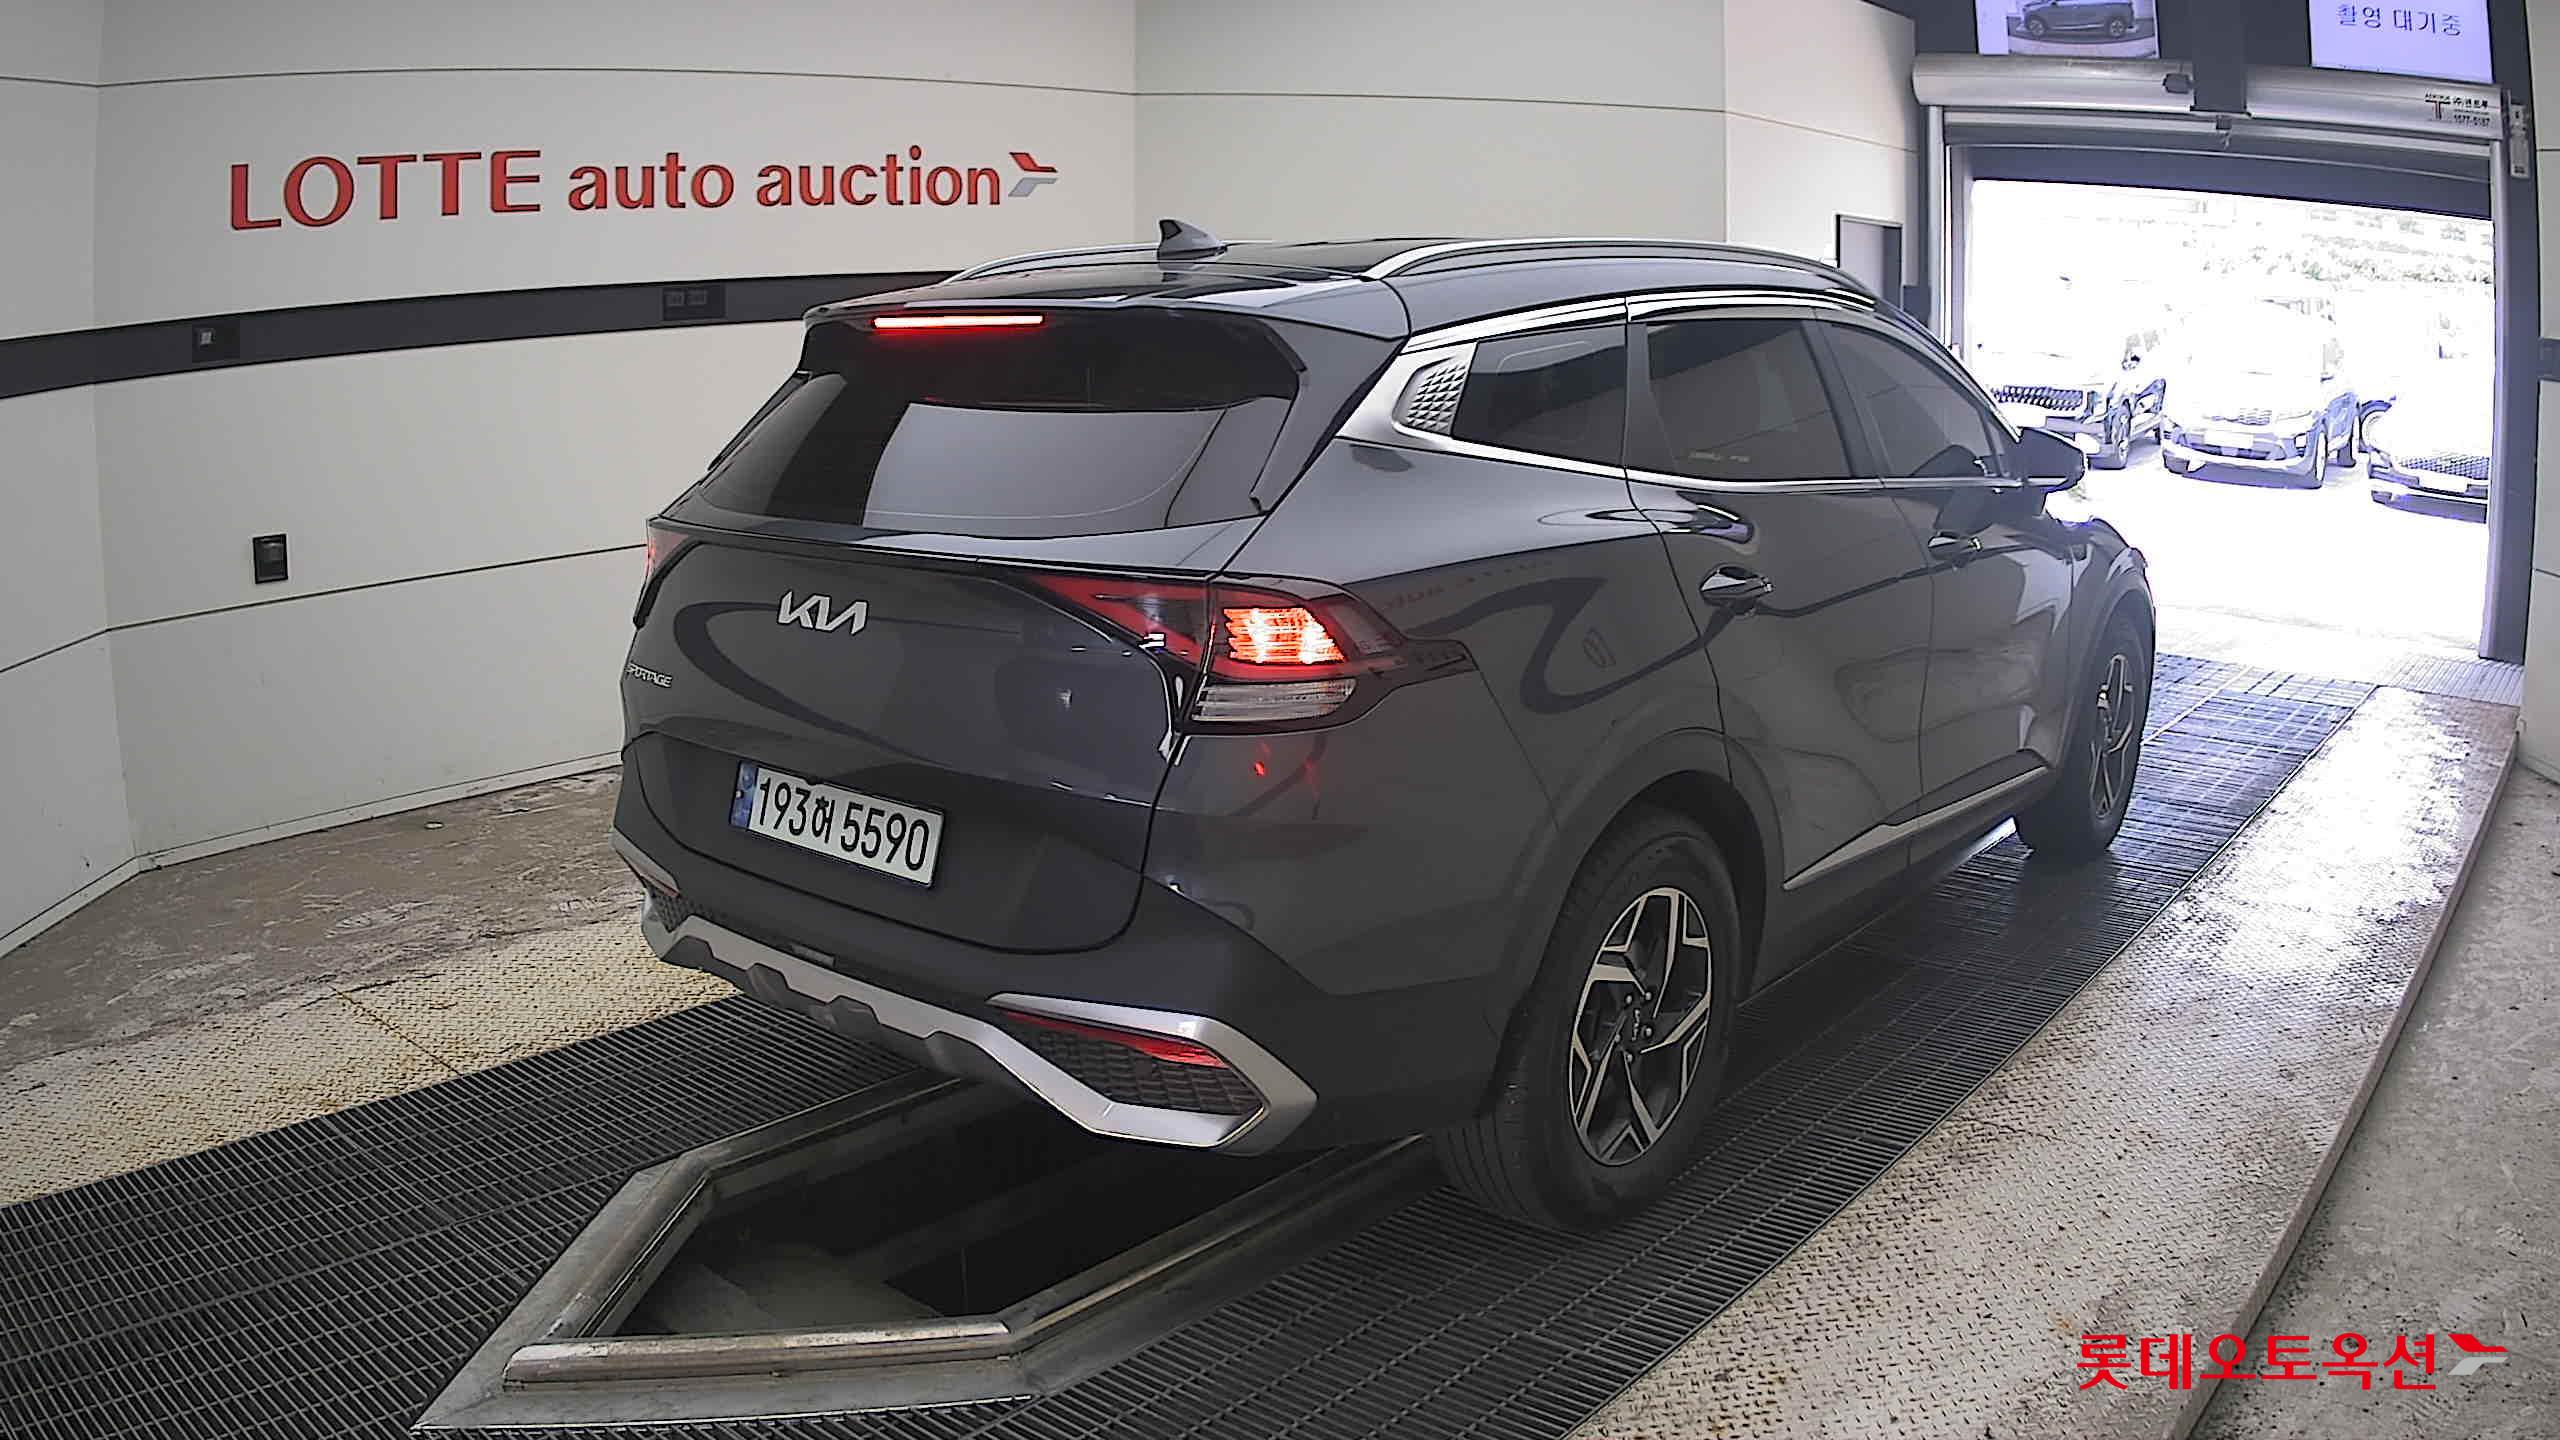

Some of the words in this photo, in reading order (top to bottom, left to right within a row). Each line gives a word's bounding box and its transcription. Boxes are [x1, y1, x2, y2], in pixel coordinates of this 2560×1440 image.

[2393, 8, 2461, 37] 대기중
[230, 149, 542, 231] LOTTE
[567, 151, 735, 210] auto
[756, 145, 1001, 208] auction
[840, 803, 930, 871] 5590
